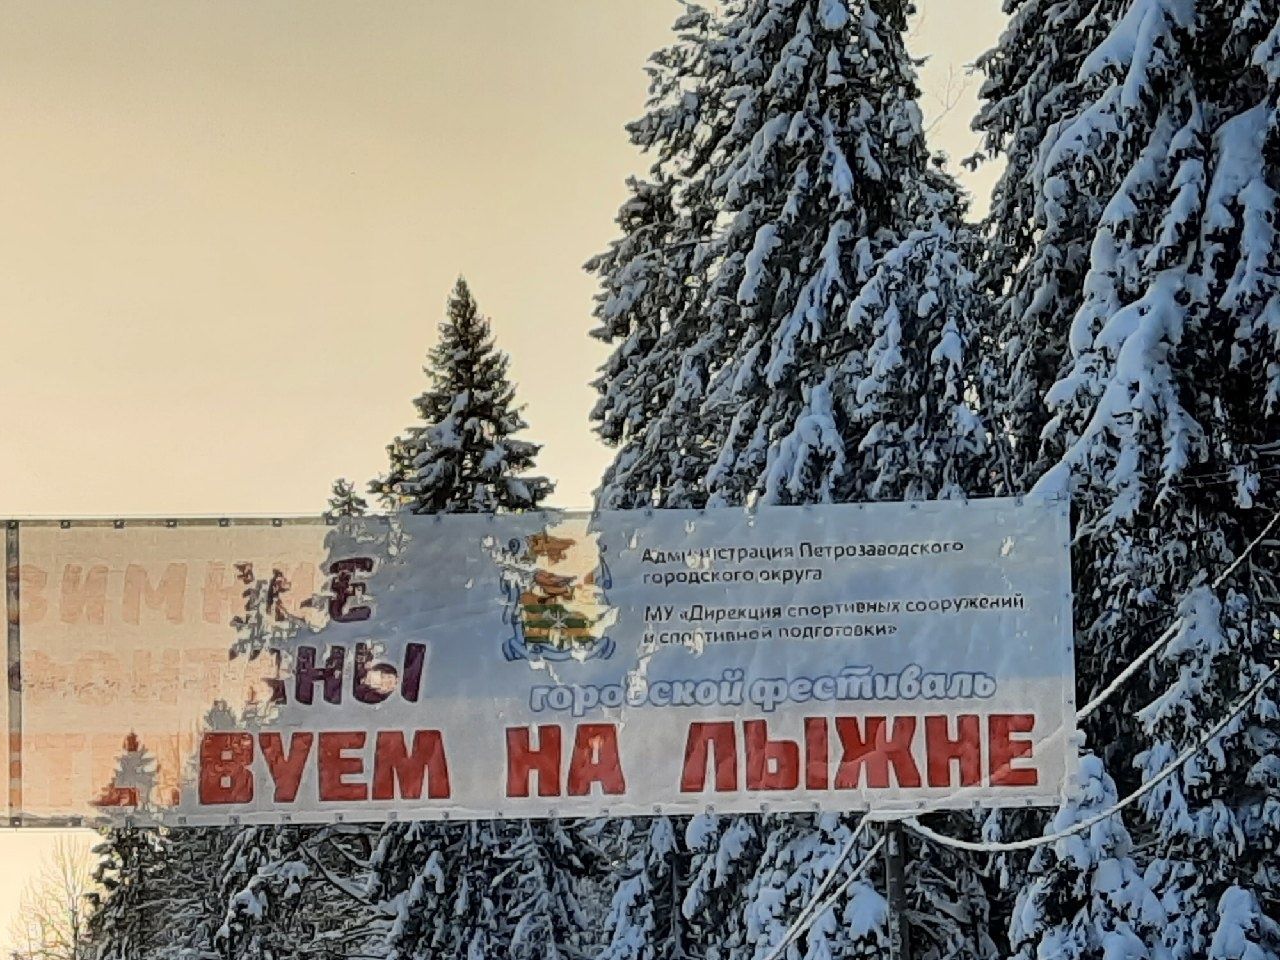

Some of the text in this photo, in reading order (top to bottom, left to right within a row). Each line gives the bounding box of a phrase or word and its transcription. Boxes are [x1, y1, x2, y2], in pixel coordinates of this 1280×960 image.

[799, 541, 964, 562] Петрозаводского
[643, 568, 823, 587] городского округа
[645, 593, 1025, 623] МУ «Дирекция спортивных сооружений
[778, 622, 898, 640] подготовки»
[529, 664, 997, 717] городской фестиваль
[506, 723, 626, 797] НА
[680, 714, 1039, 793] ЛЫЖНЕ
